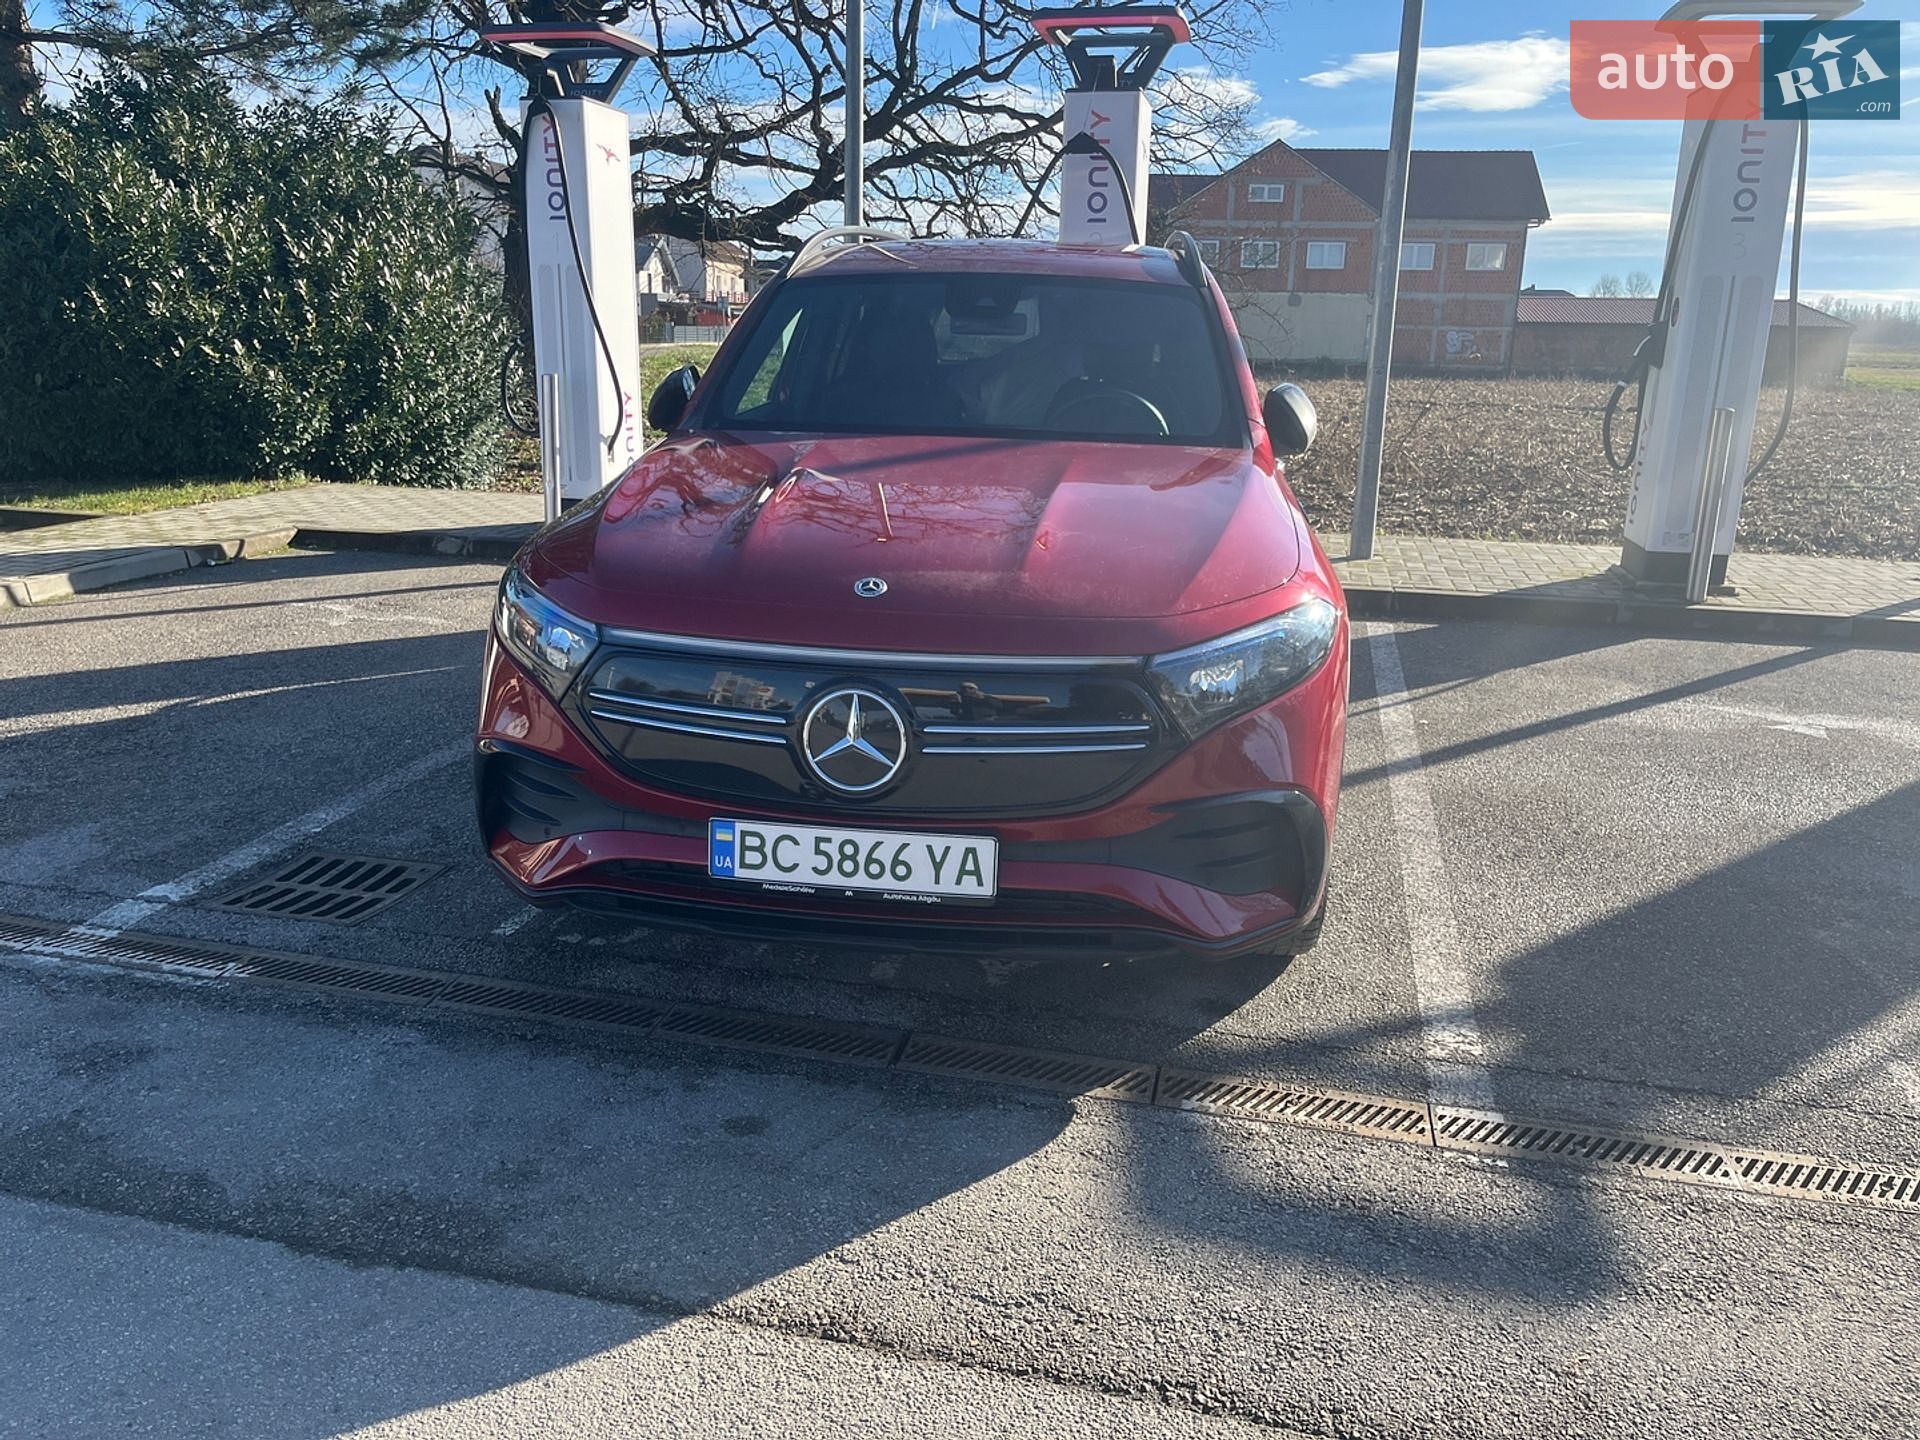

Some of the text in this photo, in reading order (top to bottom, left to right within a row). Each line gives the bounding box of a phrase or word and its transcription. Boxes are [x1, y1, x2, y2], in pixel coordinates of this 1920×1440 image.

[542, 115, 566, 221] IONITY
[624, 391, 635, 469] NITY
[714, 855, 733, 869] UA
[738, 829, 984, 888] BC 5866 YA
